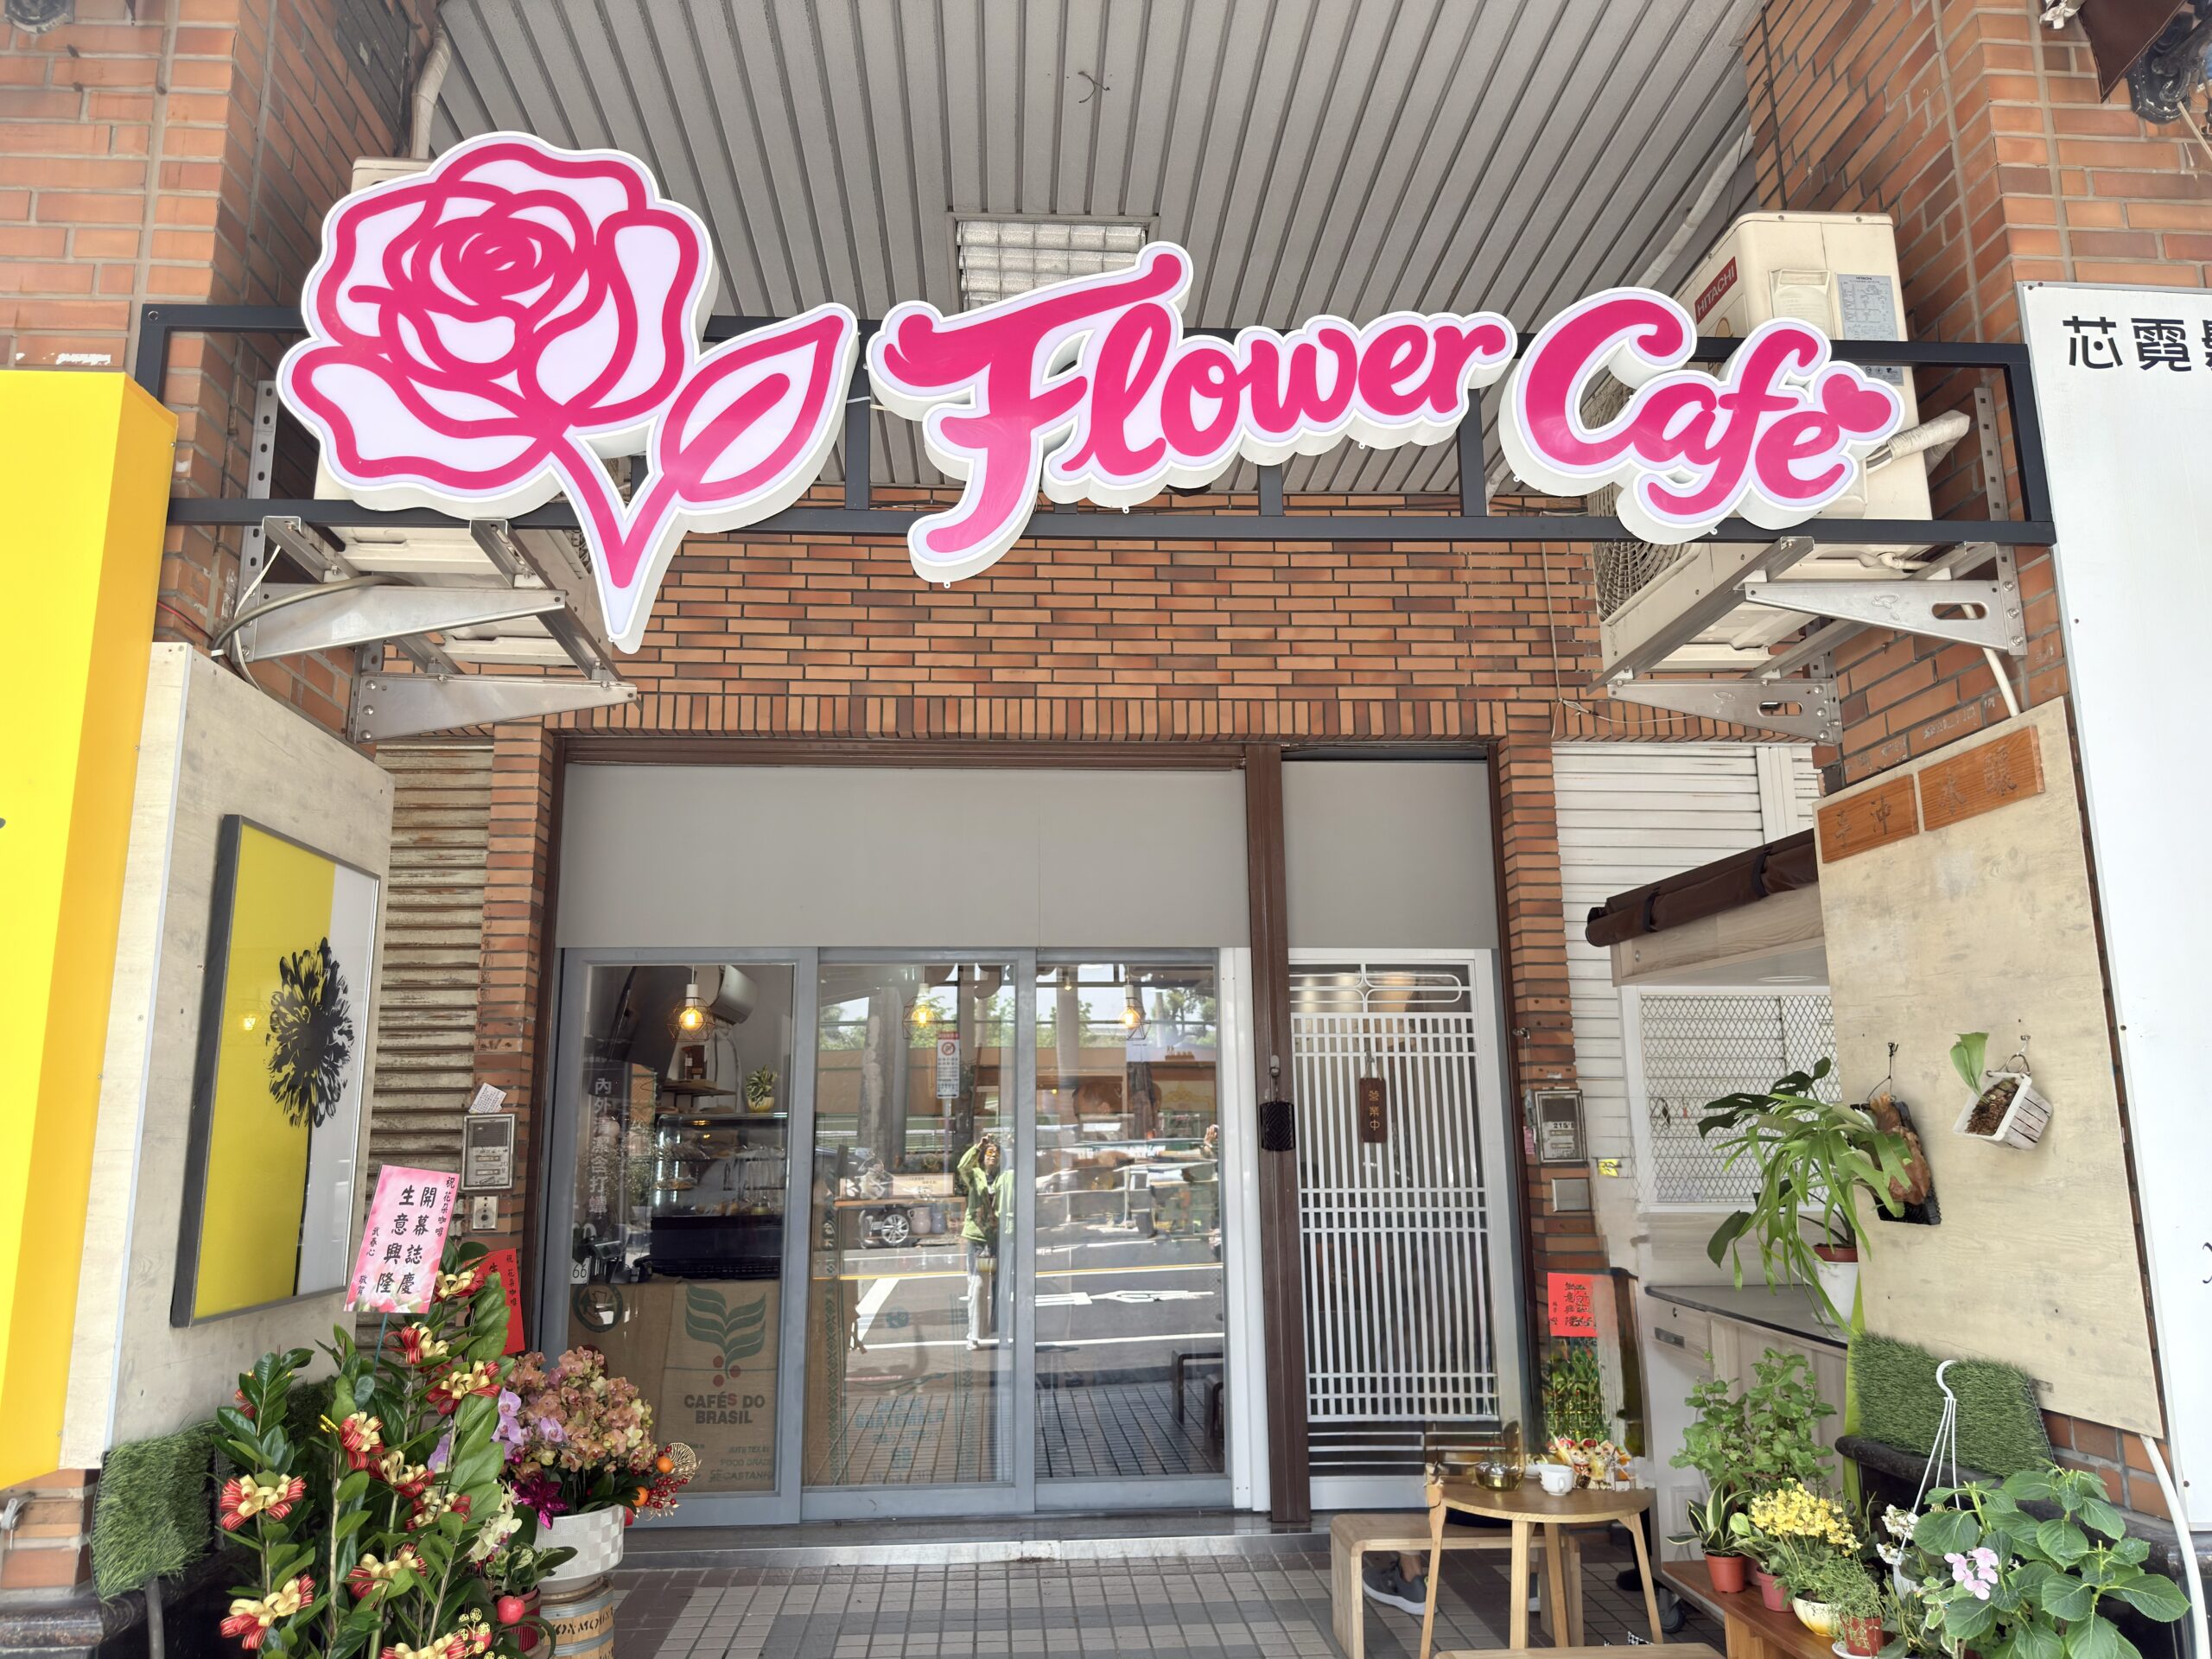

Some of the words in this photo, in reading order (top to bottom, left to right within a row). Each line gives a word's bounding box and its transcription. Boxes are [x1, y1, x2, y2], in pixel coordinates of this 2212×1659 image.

[1697, 264, 1735, 318] HITACHI
[2062, 315, 2212, 372] 芯霓
[883, 253, 1507, 553] Flower
[376, 1185, 416, 1294] 生意興隆
[397, 1186, 437, 1294] 開幕誌慶
[683, 1391, 737, 1409] CAFÉS
[742, 1394, 765, 1409] DO
[695, 1410, 753, 1426] BRASIL
